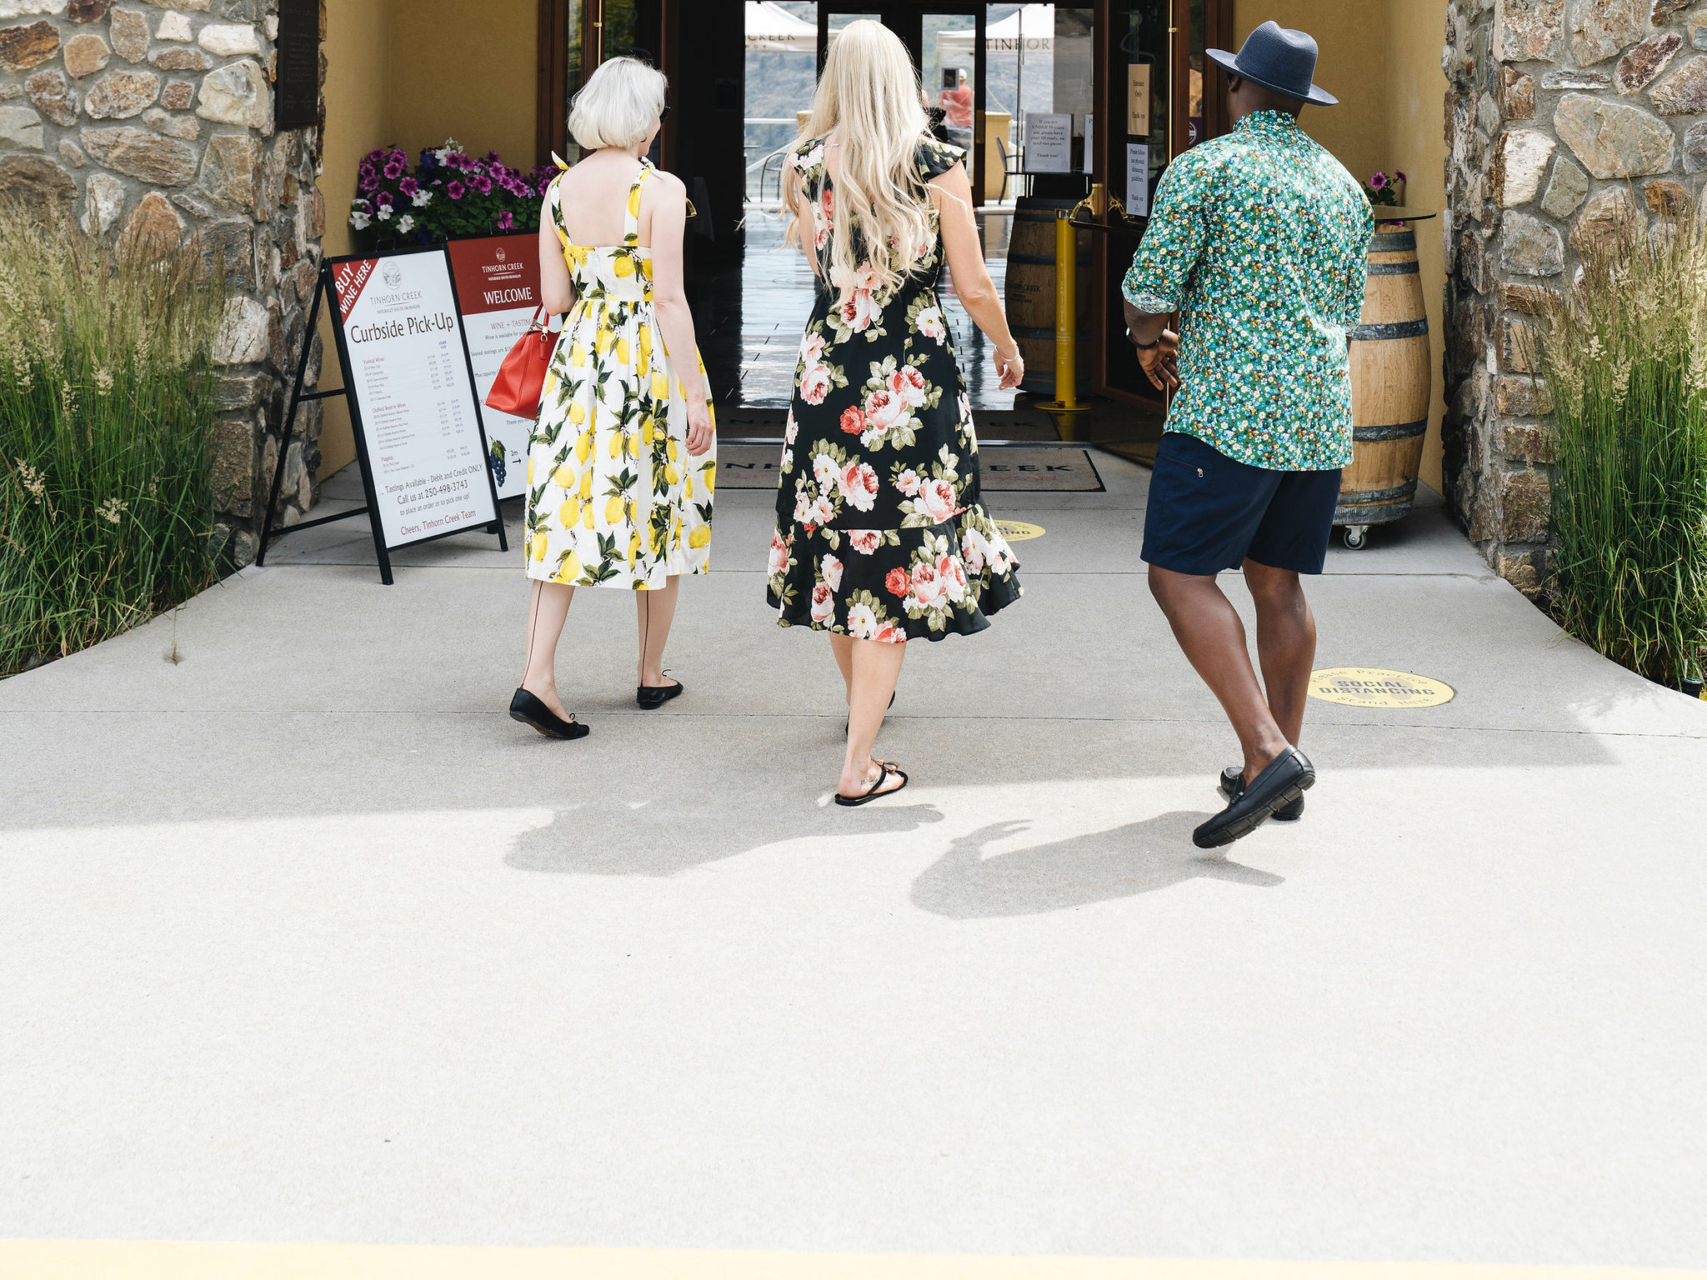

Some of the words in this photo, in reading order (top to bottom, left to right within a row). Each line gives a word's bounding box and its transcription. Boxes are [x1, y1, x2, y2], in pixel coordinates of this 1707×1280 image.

[481, 263, 507, 273] TINHORN
[507, 262, 524, 271] CREEK
[335, 263, 354, 295] BUY
[339, 285, 358, 314] WINE
[353, 259, 372, 288] HERE
[370, 294, 401, 305] TINHORN
[402, 290, 423, 301] CREEK
[483, 286, 533, 305] WELCOME
[350, 320, 405, 344] Curbside
[407, 312, 454, 335] Pick-Up
[490, 322, 505, 330] WINE
[384, 484, 405, 494] Tastings
[405, 479, 427, 489] Available
[430, 474, 444, 483] Debit
[444, 471, 453, 480] and
[453, 468, 468, 478] Credit
[468, 463, 484, 474] ONLY
[397, 494, 409, 505] Call
[418, 492, 424, 500] at
[424, 480, 469, 499] 250-498-3743
[405, 506, 417, 516] place
[423, 501, 435, 510] order
[446, 495, 455, 505] pick
[455, 494, 463, 502] one
[400, 523, 422, 536] Cheers,
[422, 517, 444, 530] Tinhorn
[444, 512, 461, 524] Creek
[461, 509, 477, 520] Team
[1318, 687, 1435, 696] DISTANCING
[1336, 680, 1408, 688] SOCIAL
[1337, 696, 1389, 706] Stand
